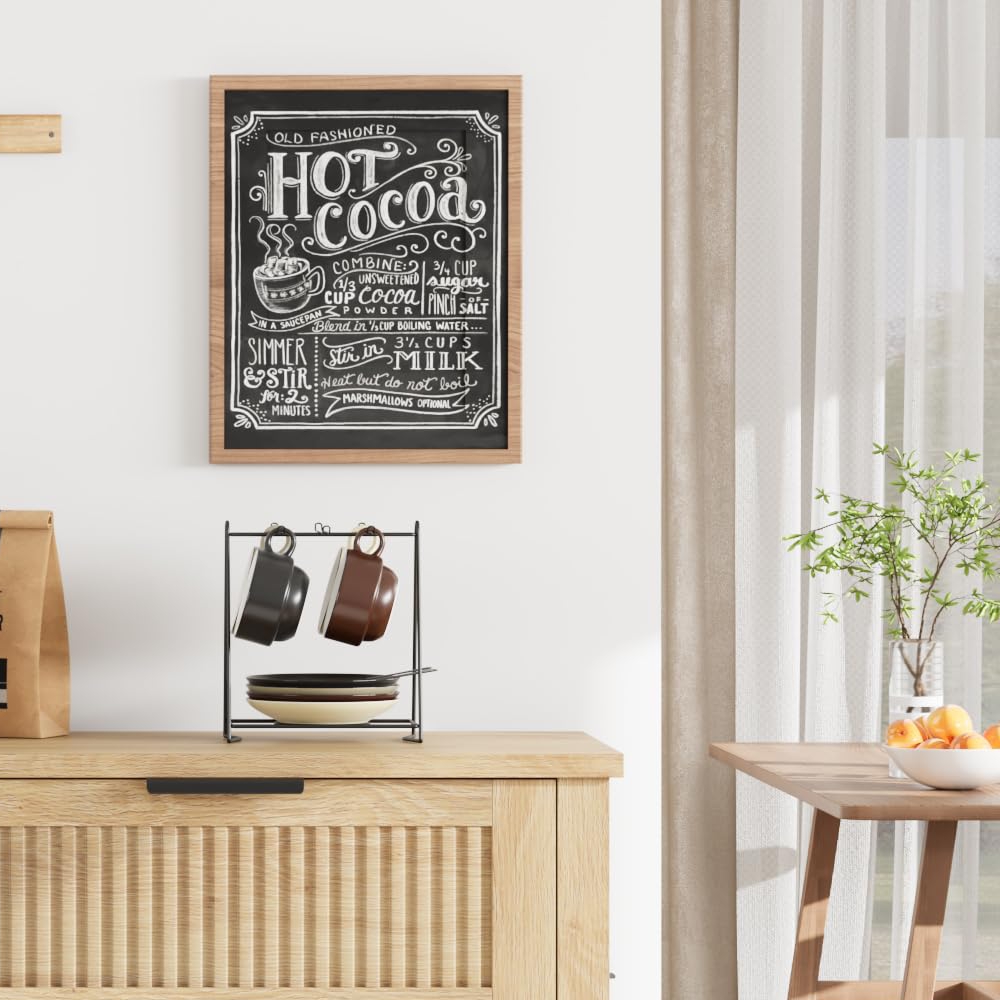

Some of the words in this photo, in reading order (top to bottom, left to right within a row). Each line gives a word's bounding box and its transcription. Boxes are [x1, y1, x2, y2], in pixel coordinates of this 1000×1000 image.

[274, 131, 303, 144] OLD
[310, 124, 396, 143] FASHIONED
[266, 141, 401, 221] HOT
[333, 257, 407, 274] COMBINE:
[433, 260, 450, 276] 3/4
[454, 260, 477, 275] CUP
[338, 277, 356, 292] 1/3
[359, 273, 420, 285] UNSWEETENED
[426, 276, 490, 295] sugar
[324, 291, 355, 304] CUP
[428, 293, 456, 316] PINCH
[459, 303, 489, 314] SALT
[343, 306, 413, 315] POWDER
[258, 320, 267, 328] IN
[280, 310, 322, 329] SAUCEPAN
[312, 321, 351, 332] Blend
[353, 320, 367, 331] in
[379, 321, 395, 331] CUP
[397, 321, 431, 331] BOILING
[425, 337, 472, 348] CUPS
[248, 337, 307, 365] SIMMER
[362, 344, 384, 360] in
[393, 351, 484, 370] MILK
[321, 374, 356, 389] Heat
[357, 373, 389, 386] but
[385, 374, 403, 388] do
[406, 377, 438, 391] not
[440, 373, 478, 391] boil
[342, 393, 413, 407] MARSHMALLOWS
[417, 398, 451, 409] OPTIONAL
[271, 405, 311, 416] MINUTES
